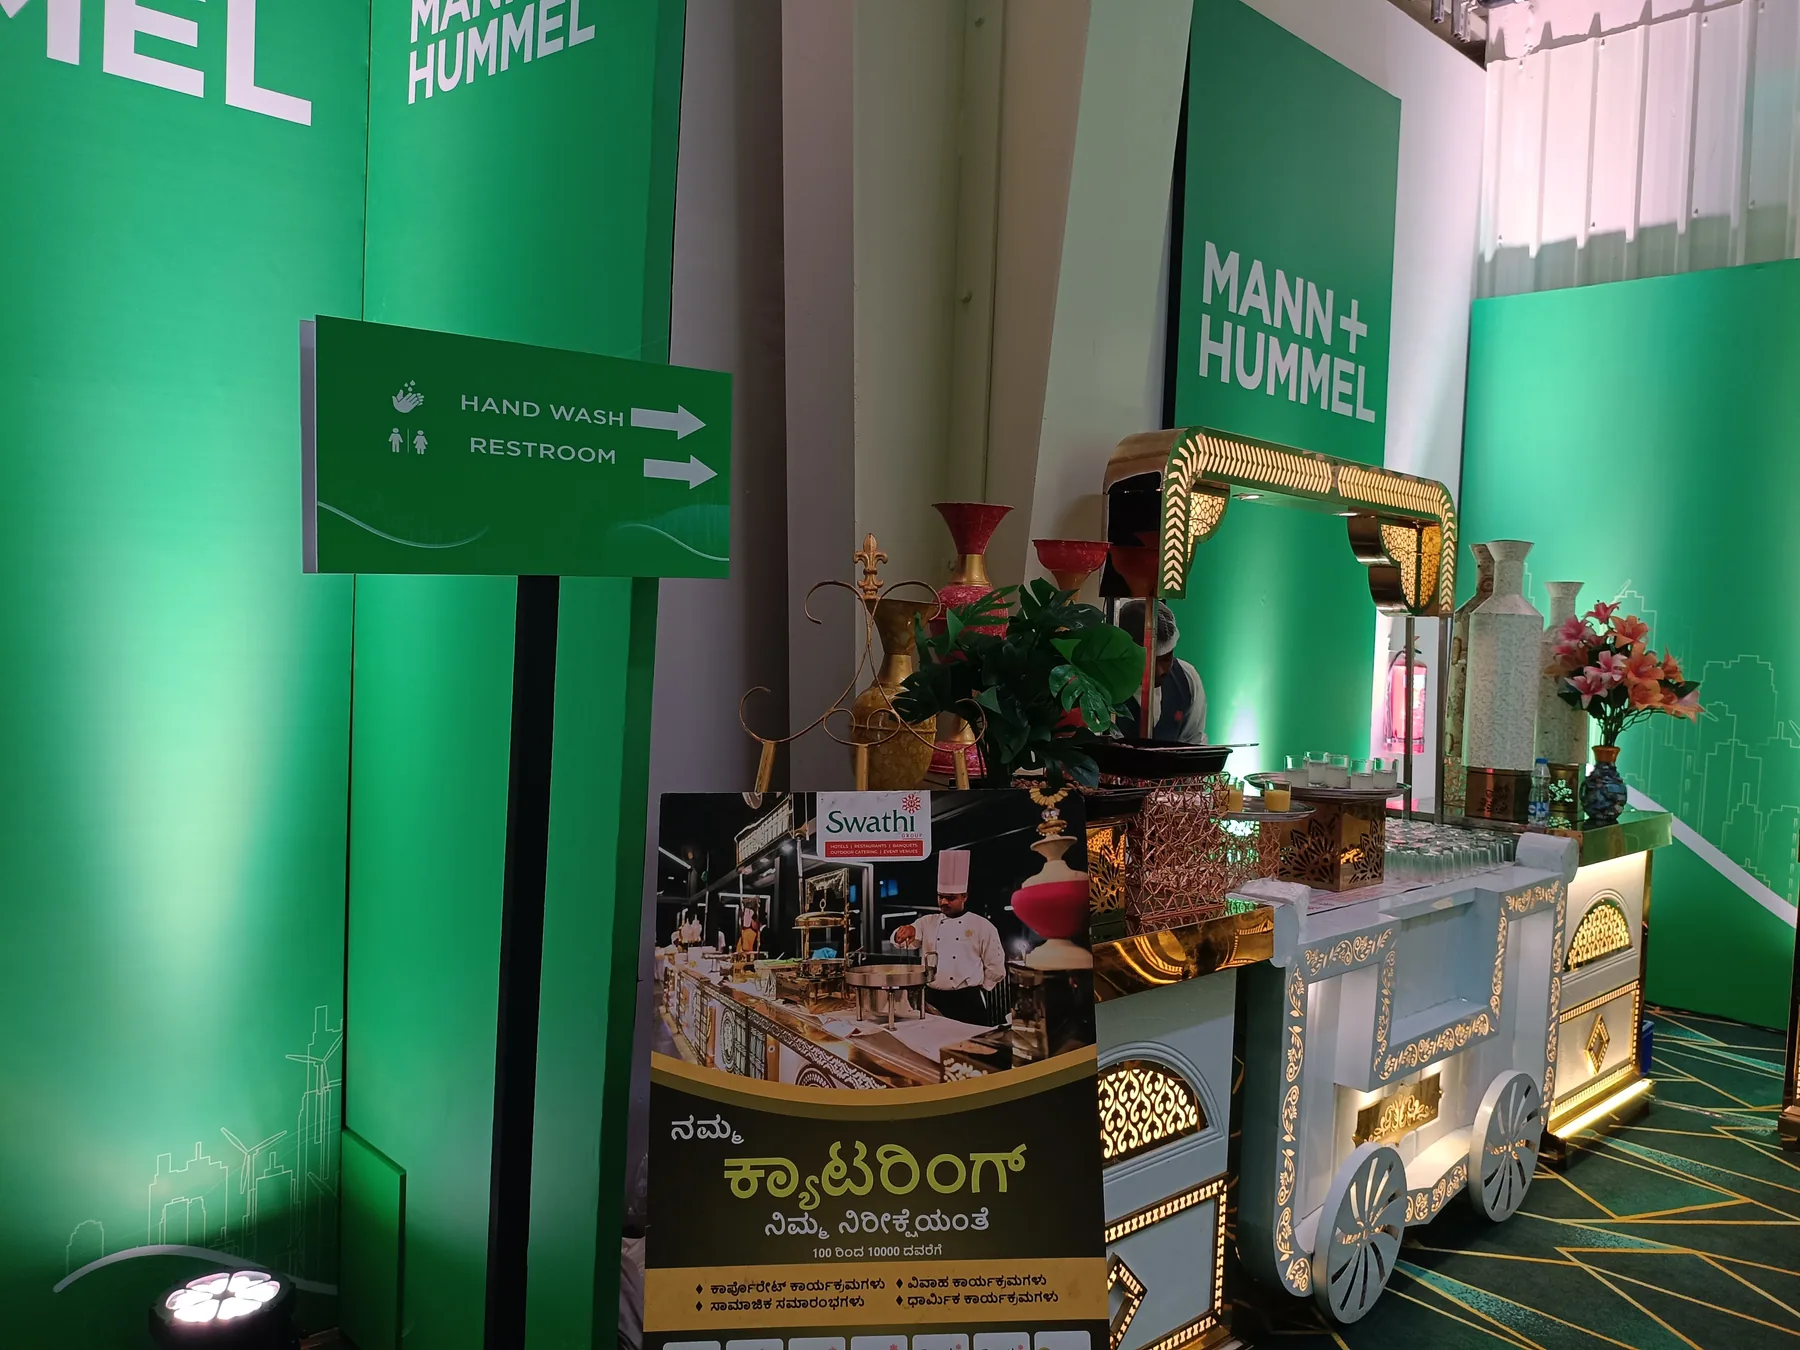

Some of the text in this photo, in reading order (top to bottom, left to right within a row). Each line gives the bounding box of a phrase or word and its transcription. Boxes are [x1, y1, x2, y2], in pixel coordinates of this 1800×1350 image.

[408, 0, 596, 105] HUMMEL
[1202, 240, 1368, 354] MANN+
[1199, 313, 1376, 423] HUMMEL
[461, 394, 625, 427] HAND WASH
[470, 437, 616, 464] RESTROOM
[825, 809, 915, 834] Swathi
[671, 1114, 744, 1144] ನಮ್ಮ
[724, 1140, 1027, 1211] ಕ್ಯಾಟರಿಂಗ್
[764, 1206, 990, 1240] ನಿಮ್ಮ ನಿರೀಕ್ಷೆಯಂತೆ
[812, 1244, 943, 1259] 100 ರಿಂದ 10000 ದವರೆಗೆ
[790, 1277, 885, 1293] ಕಾರ್ಯಕ್ರಮಗಳು
[907, 1273, 1047, 1289] ವಿವಾಹ ಕಾರ್ಯಕ್ರಮಗಳು
[710, 1295, 865, 1312] ಸಾಮಾಜಿಕ ಸಮಾರಂಭಗಳು
[907, 1290, 1059, 1308] ಧಾರ್ಮಿಕ ಕಾರ್ಯಕ್ರಮಗಳು
